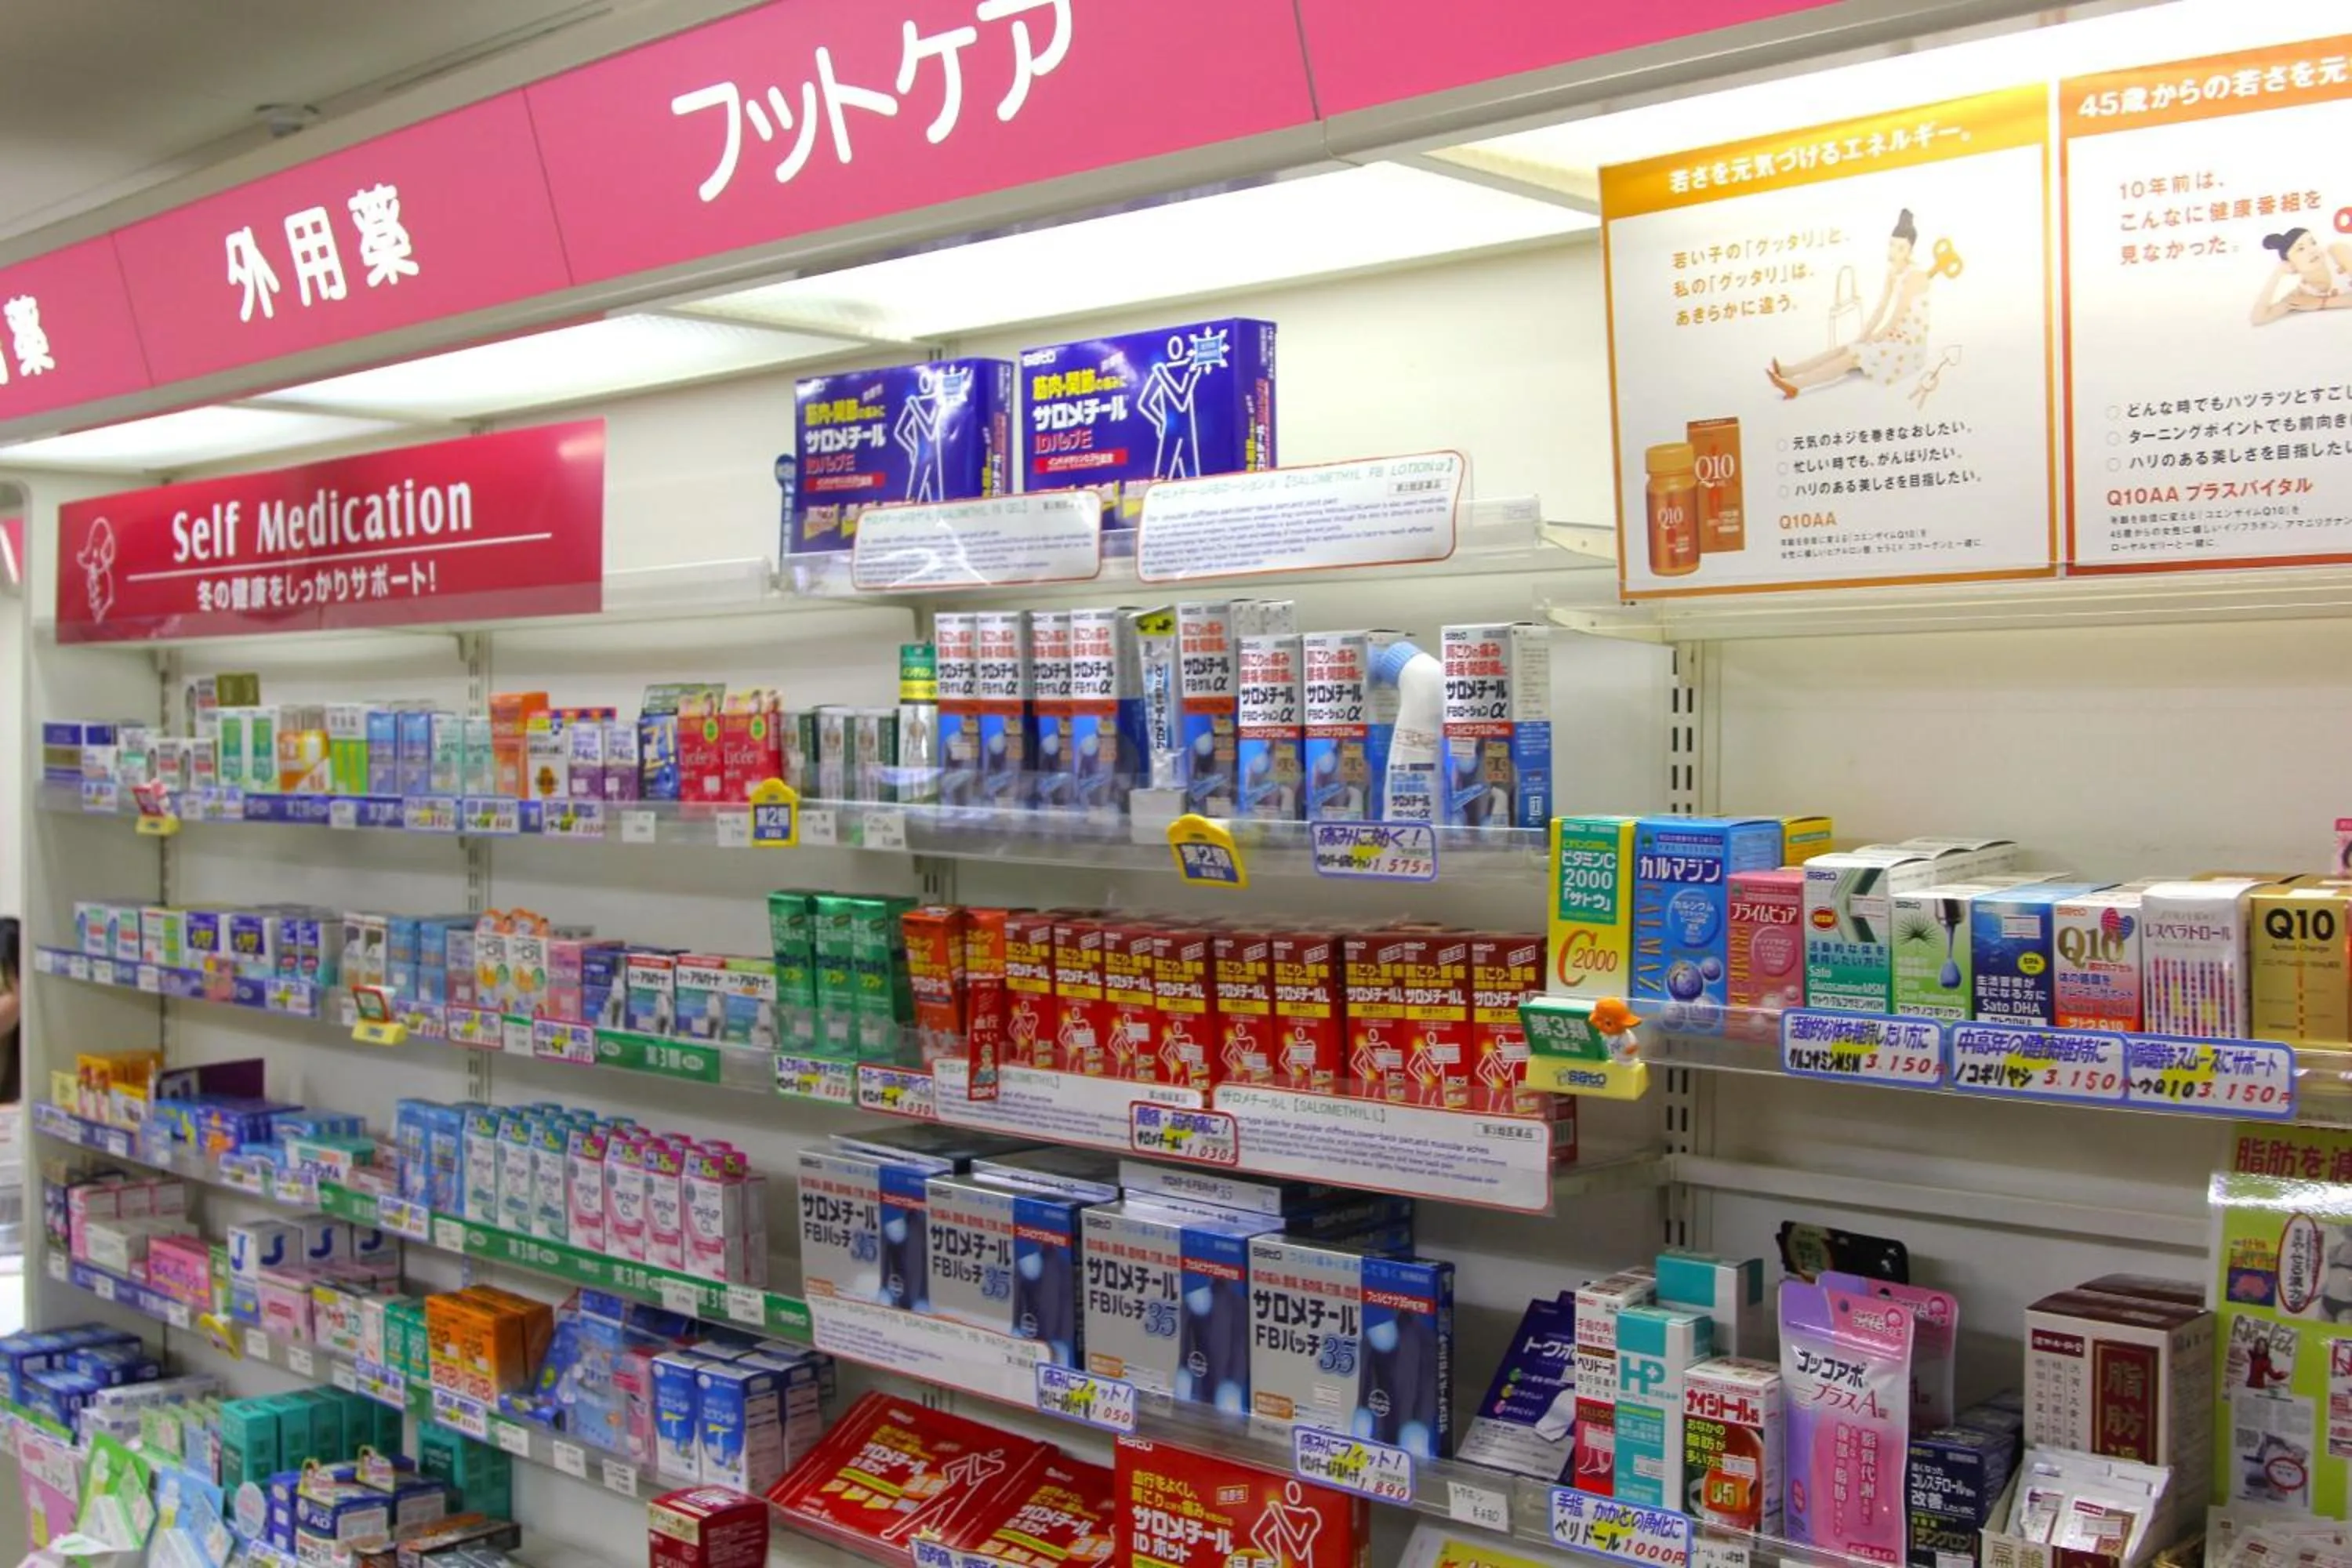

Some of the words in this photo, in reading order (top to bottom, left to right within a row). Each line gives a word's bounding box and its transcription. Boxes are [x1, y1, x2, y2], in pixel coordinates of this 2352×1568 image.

[671, 0, 1072, 202] フットケア
[2078, 56, 2352, 118] 45歳からの若さを元
[1669, 122, 1971, 194] 若さを元気づけるエネルギー。
[2119, 172, 2225, 200] 10年前は、
[2119, 190, 2322, 231] こんなに健康番組を
[225, 183, 420, 322] 外用薬
[1671, 227, 1851, 270] 若い子の「グッタリ」と、
[2120, 236, 2240, 265] 見なかった。
[1673, 263, 1814, 298] 私の「グッタリ」は、
[1675, 293, 1798, 326] あきらかに違う。
[0, 295, 55, 385] 薬
[1033, 395, 1127, 430] サロメチール
[805, 423, 886, 453] サロメチール
[1792, 420, 1973, 451] 元気のネジを巻きなおしたい。
[2128, 412, 2352, 445] ターニングポイントでも前向き
[1694, 453, 1735, 490] Q10
[1793, 445, 1963, 474] 忙しい時でも、がんばりたい。
[1794, 470, 1983, 499] ハリのある美しさを目指したい。
[2107, 485, 2180, 507] Q10AA
[2186, 477, 2314, 503] プラスバイタル
[172, 499, 241, 564] Self
[256, 477, 473, 555] Medication
[1779, 510, 1838, 531] Q10AA
[1184, 657, 1230, 674] サロメチール
[1242, 687, 1296, 705] サロメチール
[1307, 684, 1363, 704] サロメチール
[1445, 680, 1508, 702] サロメチール
[1562, 850, 1617, 870] ビタミンC
[1639, 856, 1722, 884] カルマジン
[1564, 869, 1613, 890] 2000
[1563, 887, 1611, 912] 「サトウ」
[1730, 902, 1798, 924] プライムピュア
[2264, 907, 2336, 942] Q10
[2057, 926, 2125, 969] Q10
[1275, 985, 1330, 1004] サロメチールL
[1346, 985, 1403, 1004] サロメチールL
[1406, 988, 1466, 1006] サロメチールL
[1982, 999, 2010, 1014] Sato
[2012, 1000, 2042, 1015] DHA
[1955, 1060, 2034, 1087] ノコギリヤシ
[2128, 1077, 2195, 1098] トウQ10
[802, 1192, 878, 1231] サロメチール
[930, 1223, 1012, 1267] サロメチール
[1087, 1257, 1179, 1300] サロメチール
[1253, 1288, 1359, 1336] サロメチール
[1523, 1336, 1577, 1361] トクホ
[1620, 1356, 1666, 1396] HP
[1797, 1350, 1867, 1389] コッコアポ
[1131, 1504, 1234, 1555] サロメチール
[1555, 1519, 1621, 1553] ペリドール
[1623, 1537, 1688, 1566] 1000円
[1133, 1532, 1149, 1552] ID
[1153, 1537, 1192, 1563] ホット
